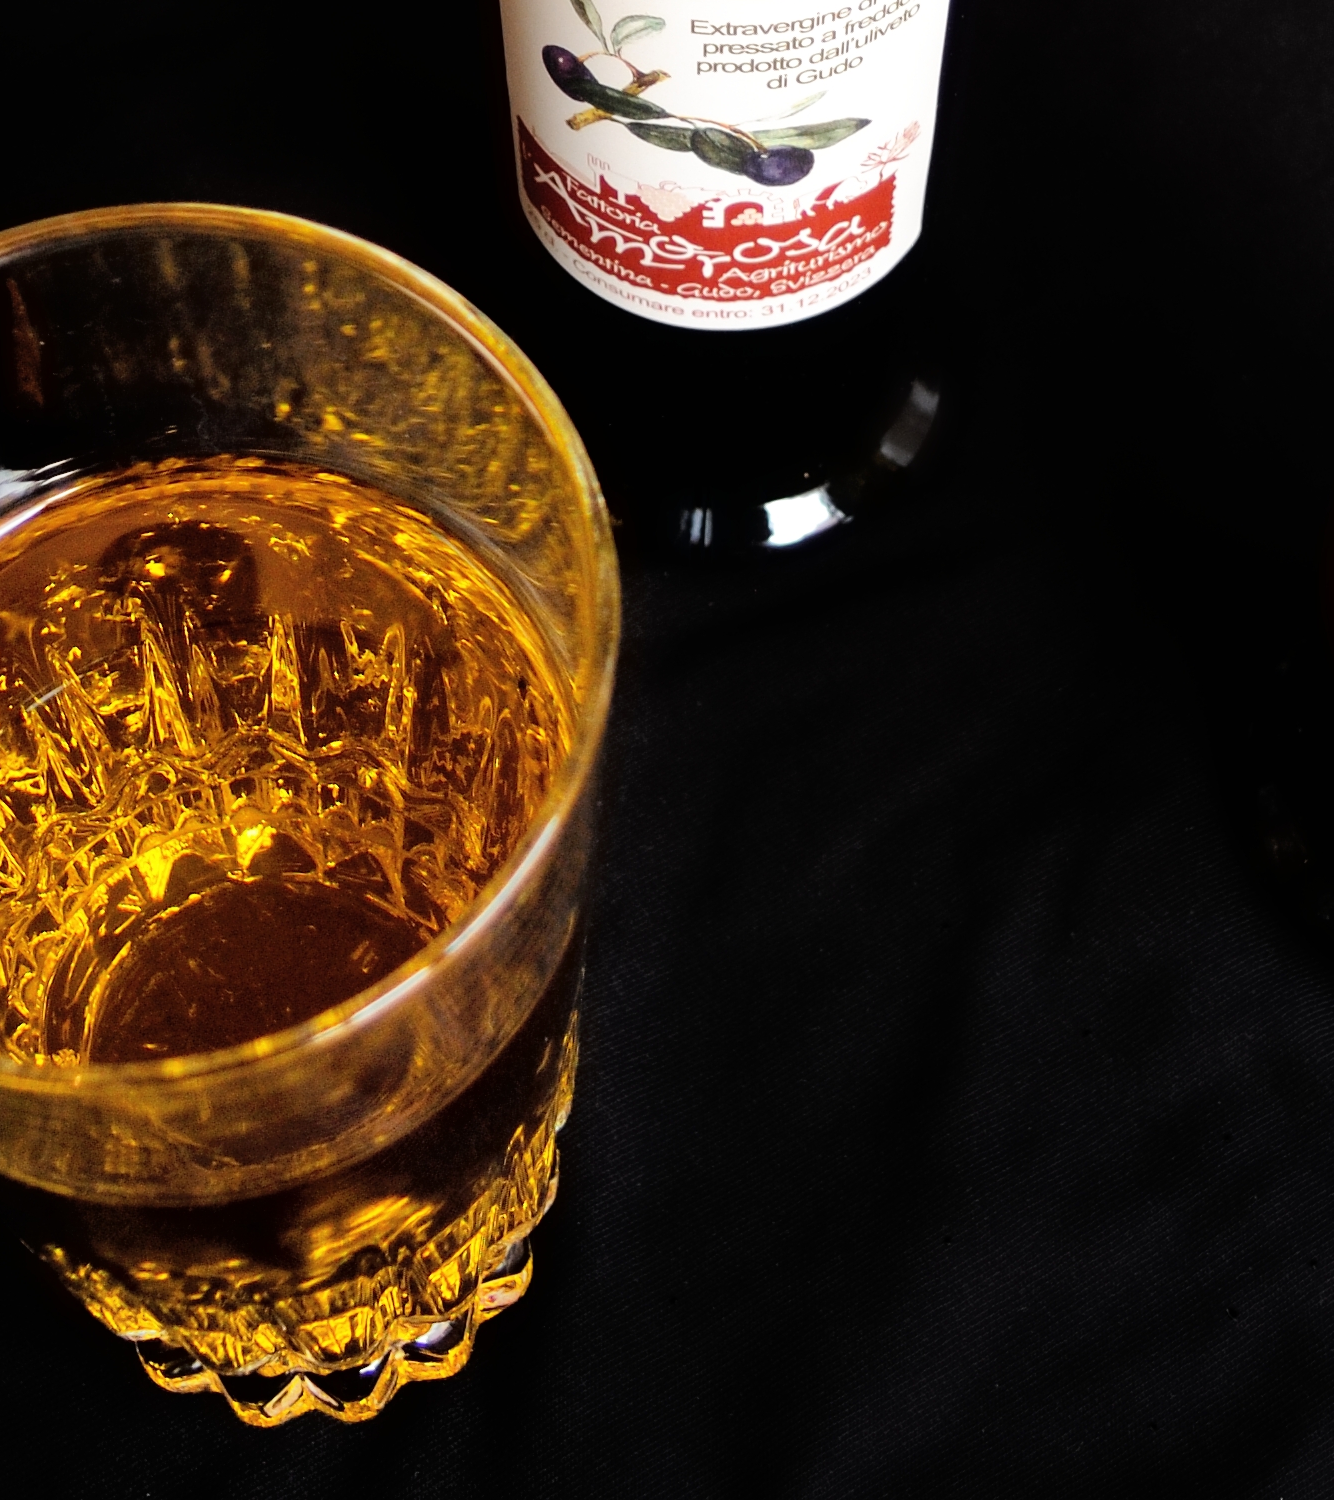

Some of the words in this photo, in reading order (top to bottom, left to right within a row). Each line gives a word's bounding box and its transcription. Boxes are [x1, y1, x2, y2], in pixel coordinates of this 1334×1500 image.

[689, 6, 853, 37] Extravergine
[696, 56, 803, 75] prodotto
[809, 3, 921, 65] dall'uliveto
[702, 36, 815, 58] pressato
[821, 30, 837, 44] a
[766, 74, 788, 90] di
[795, 55, 864, 86] Gudo
[562, 170, 662, 235] Fattoria
[540, 205, 654, 288] Sementina
[717, 220, 889, 284] Agriturismo
[572, 258, 685, 316] Consumare
[691, 303, 754, 320] entro:
[760, 266, 872, 317] 31.12.2023
